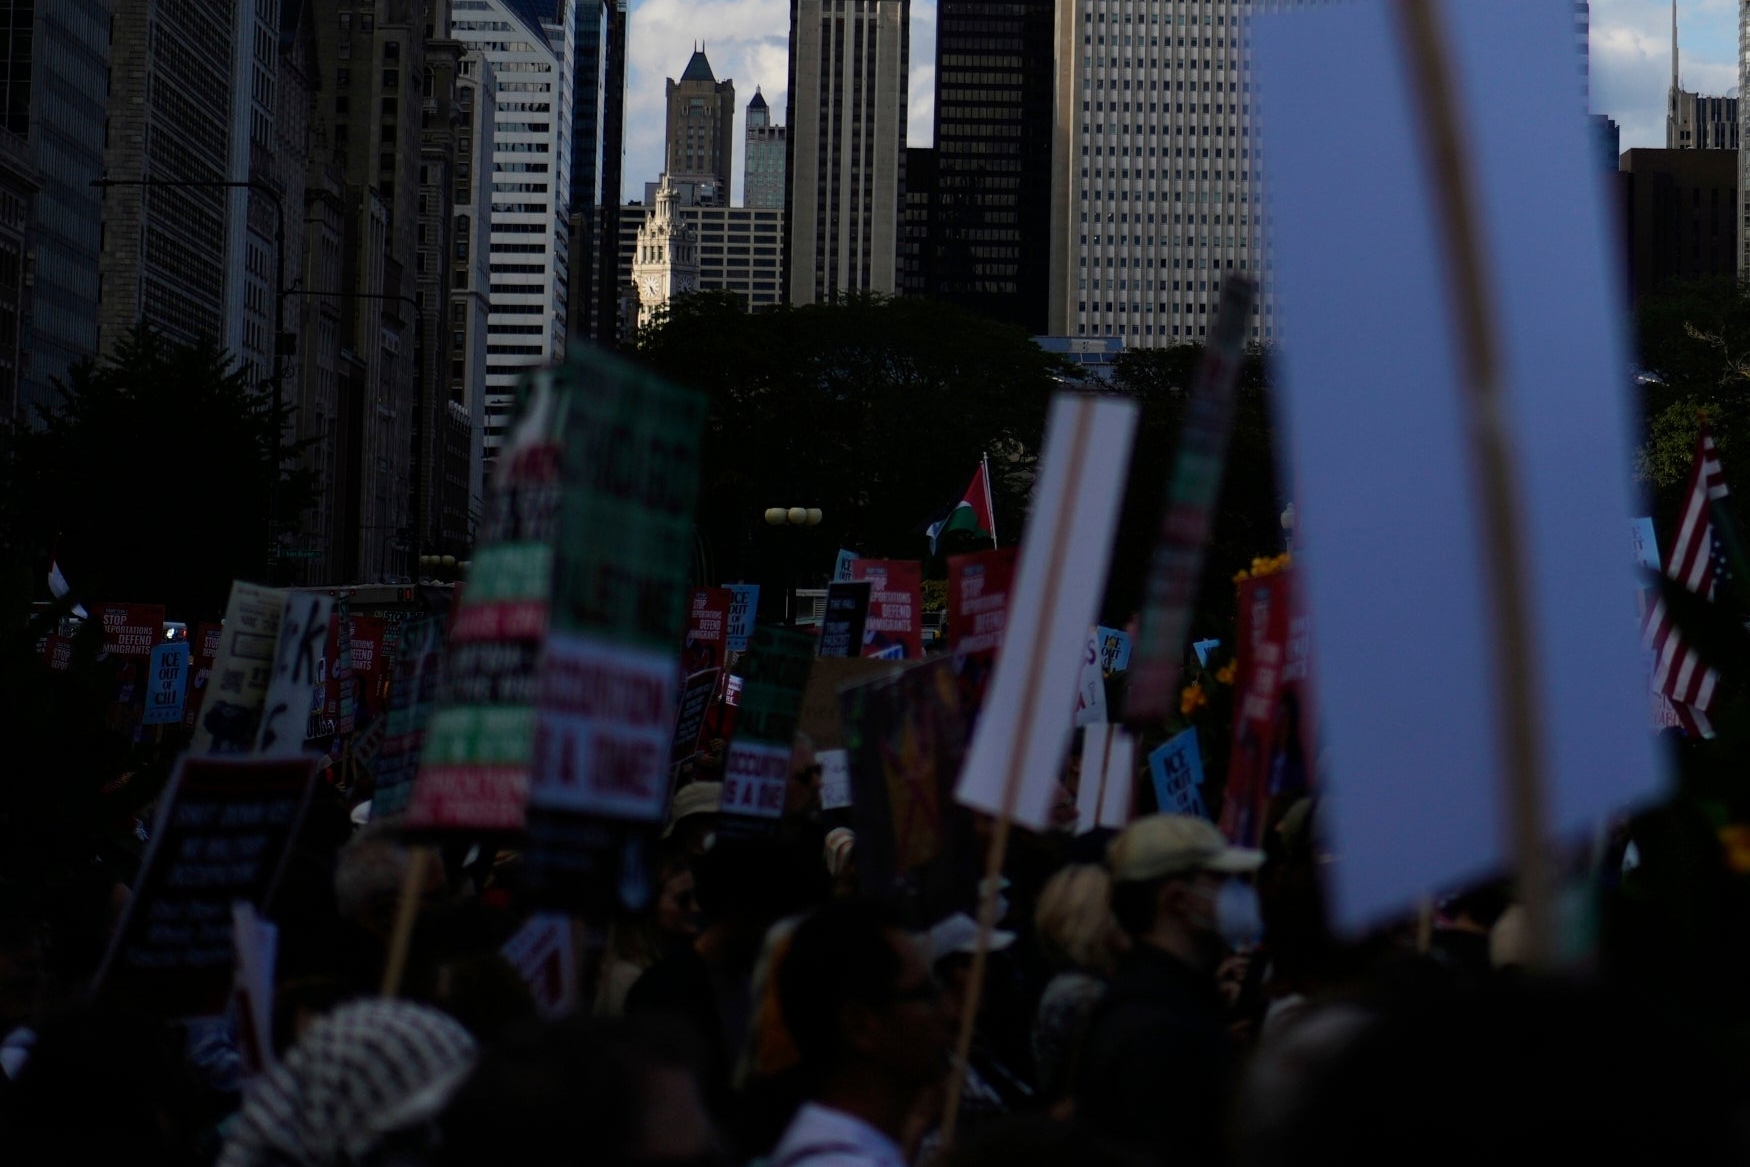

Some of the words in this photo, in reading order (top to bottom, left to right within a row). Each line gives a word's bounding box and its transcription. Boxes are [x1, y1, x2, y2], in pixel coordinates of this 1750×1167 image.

[870, 592, 912, 603] EPORTATIONS
[103, 615, 127, 625] STOP
[118, 635, 152, 645] DEFEND
[52, 648, 71, 662] STOP
[102, 644, 151, 655] MMIGRANTS
[160, 651, 180, 668] ICE
[158, 667, 179, 682] OUT
[162, 681, 174, 691] OF
[155, 690, 178, 706] CHI
